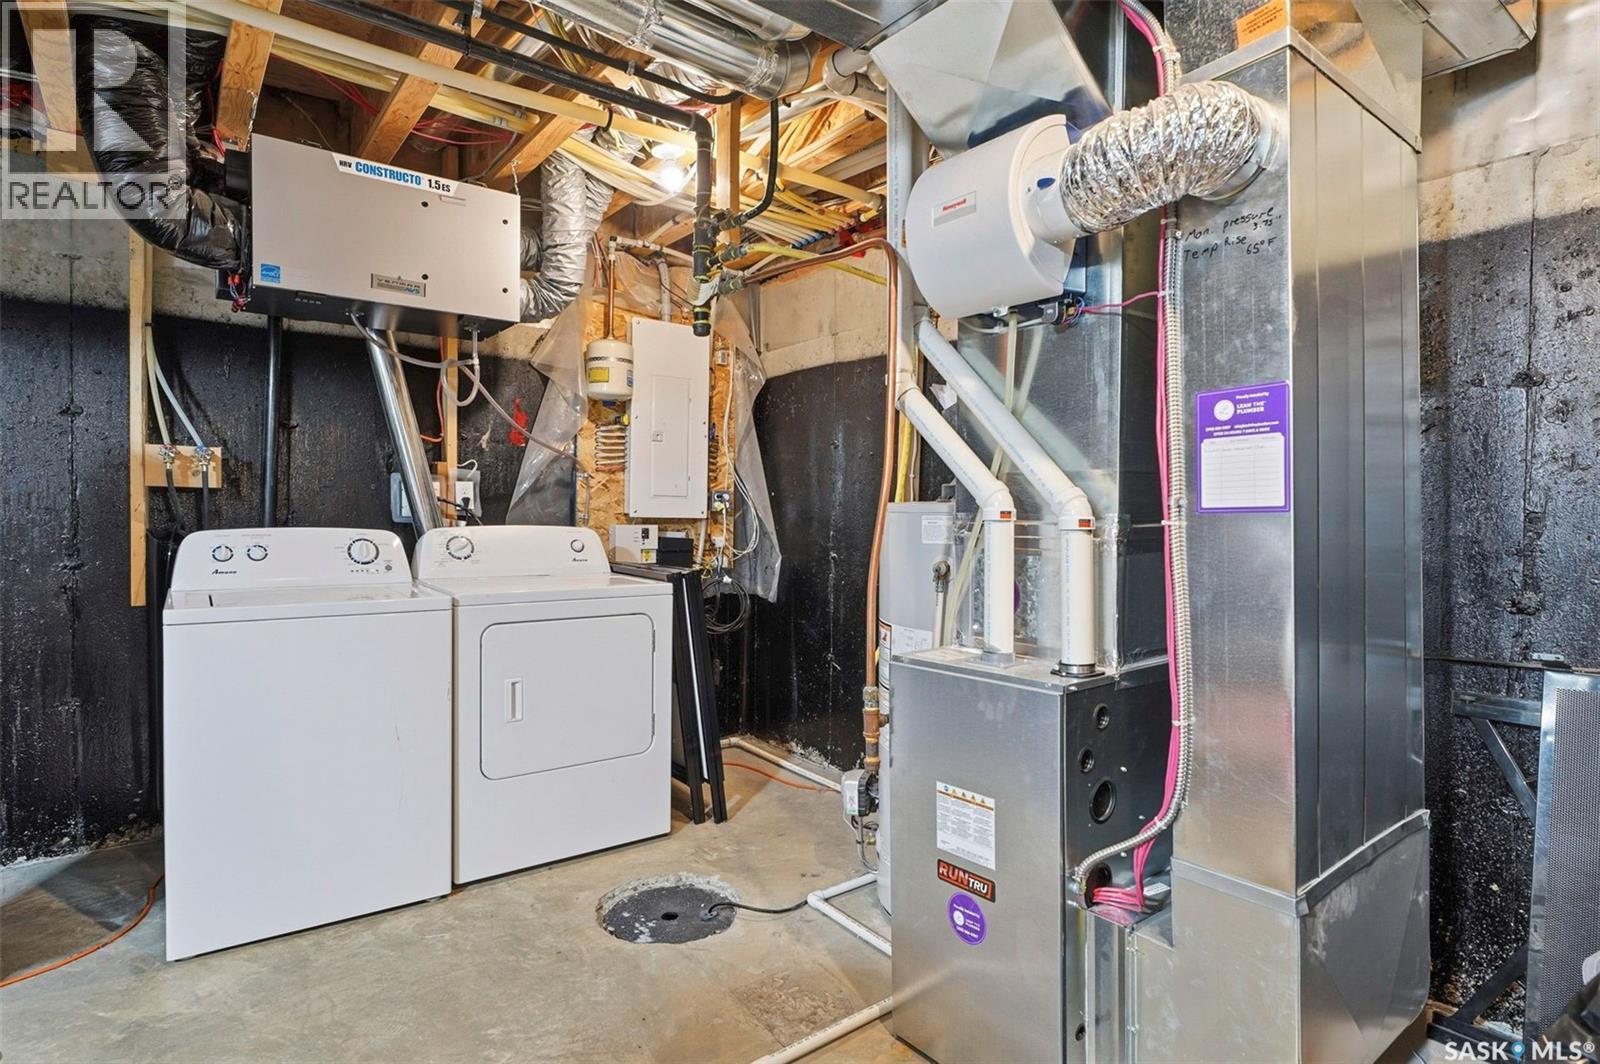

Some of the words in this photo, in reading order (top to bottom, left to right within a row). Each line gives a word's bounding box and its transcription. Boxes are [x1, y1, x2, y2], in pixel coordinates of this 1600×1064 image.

[355, 161, 422, 186] CONSTRUCTO
[1222, 206, 1274, 234] pressure
[1183, 243, 1219, 262] Temp
[1224, 236, 1247, 247] Rise
